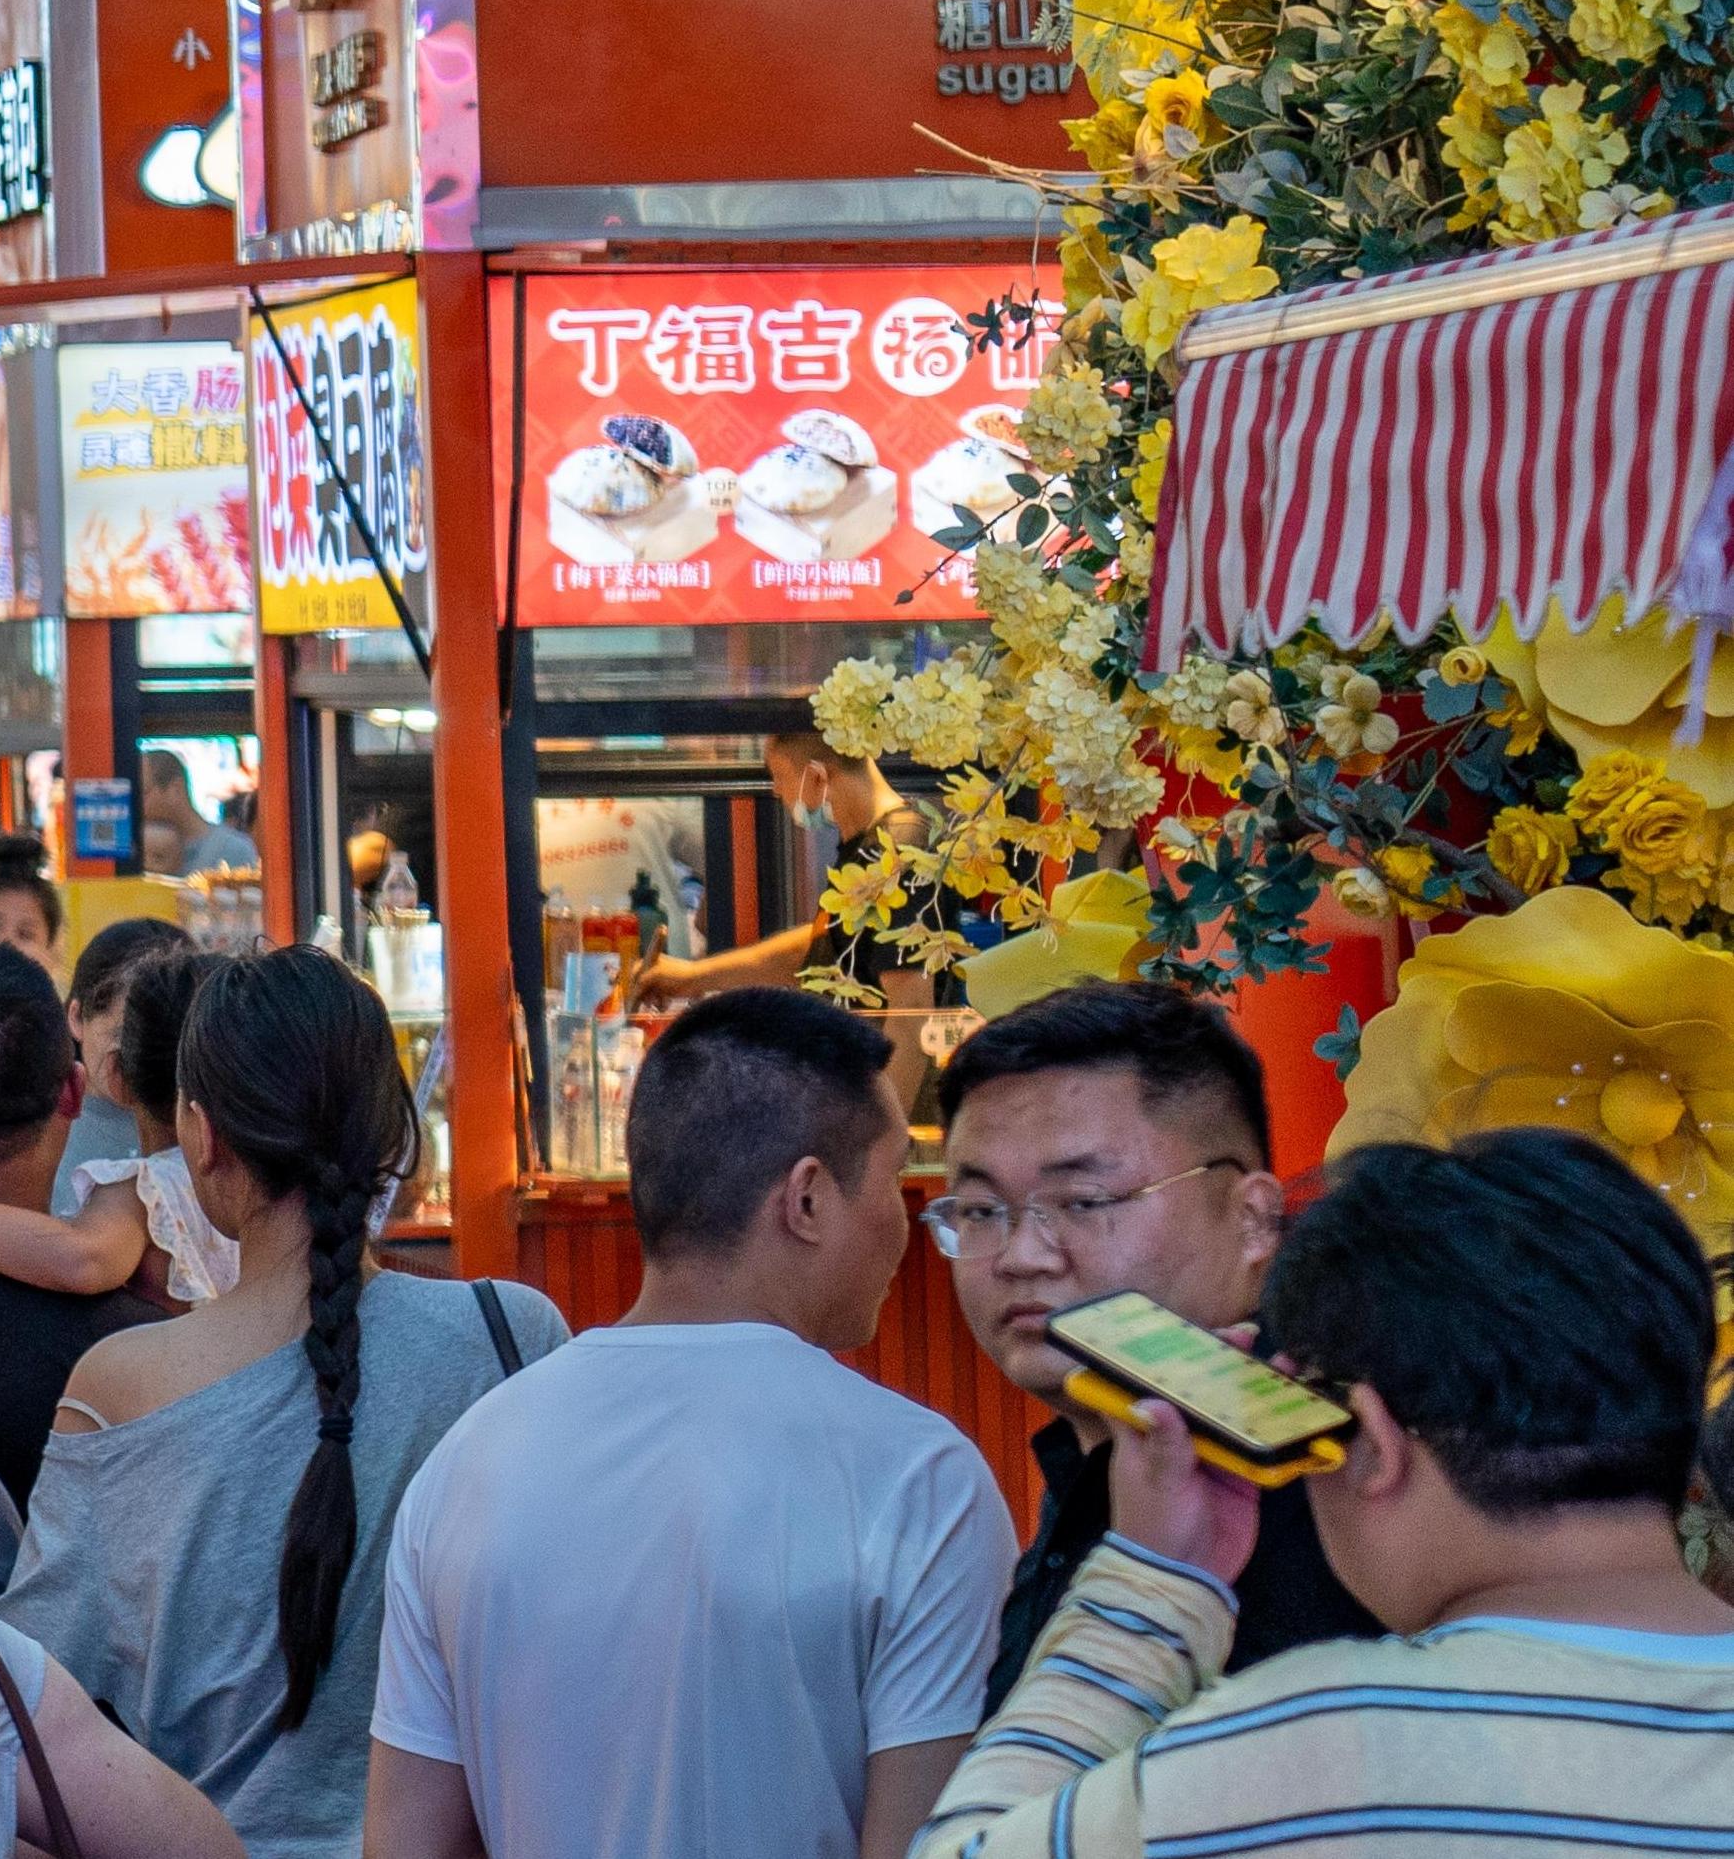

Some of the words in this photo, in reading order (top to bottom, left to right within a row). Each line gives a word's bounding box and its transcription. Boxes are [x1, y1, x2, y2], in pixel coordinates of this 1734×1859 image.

[937, 61, 1077, 104] sugar
[91, 365, 241, 416] 大香肠
